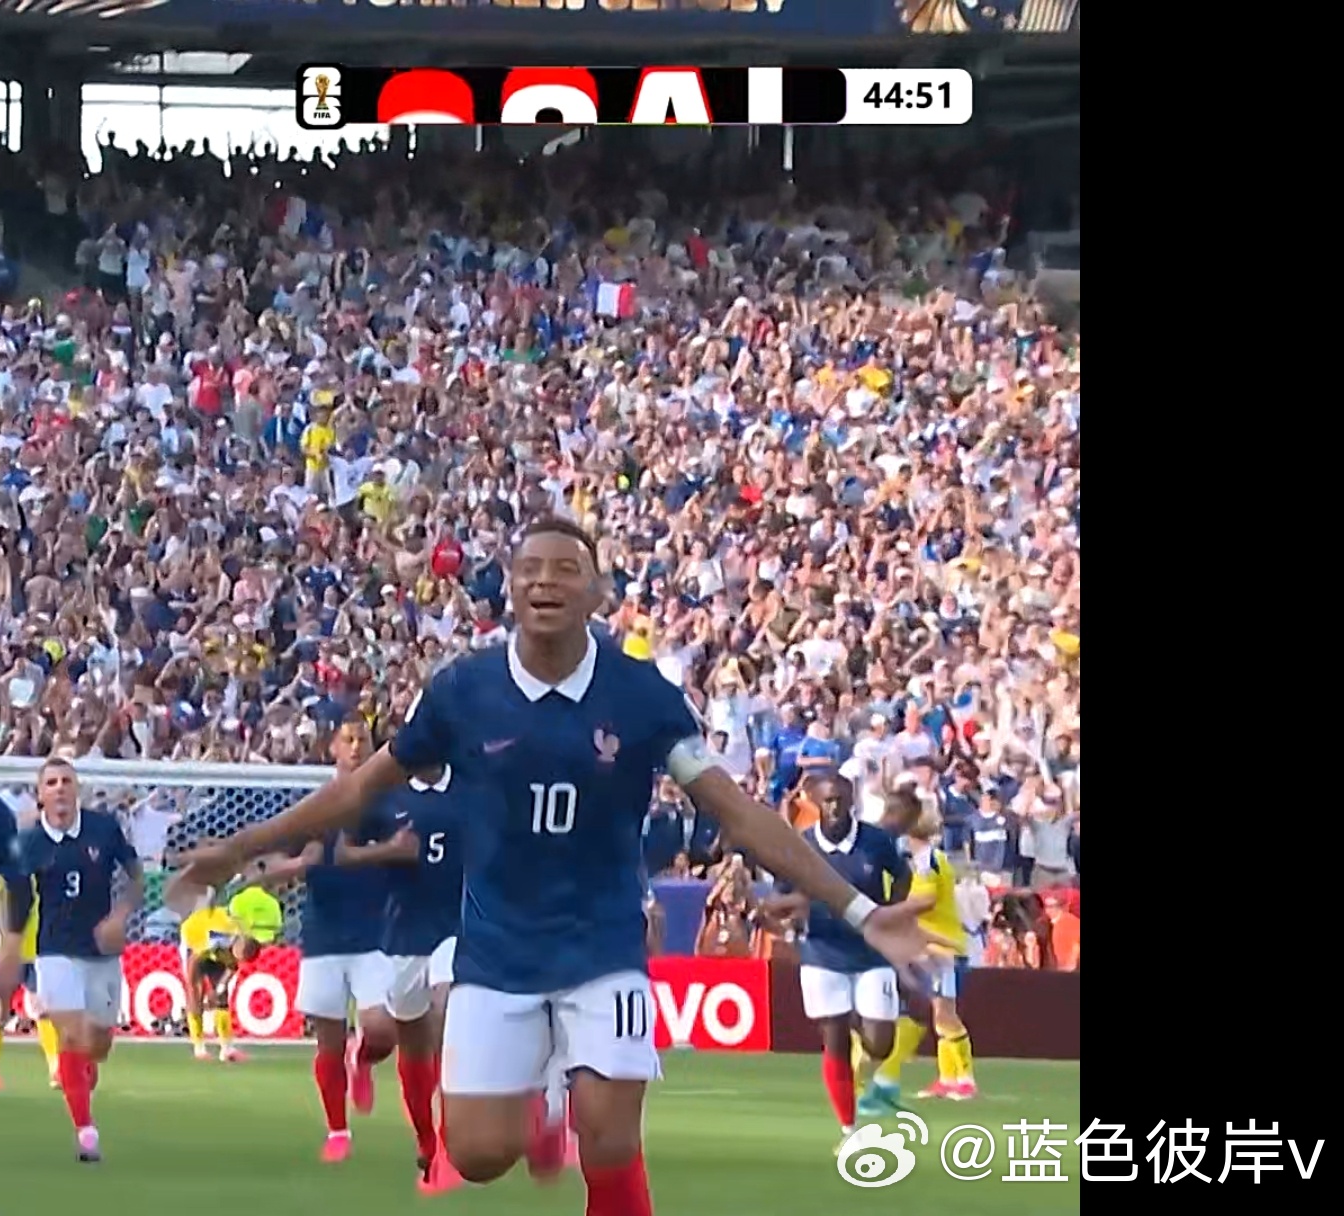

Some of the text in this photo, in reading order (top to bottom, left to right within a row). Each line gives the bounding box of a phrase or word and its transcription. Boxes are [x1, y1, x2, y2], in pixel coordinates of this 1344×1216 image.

[530, 783, 578, 833] 10
[427, 832, 445, 863] 5
[613, 990, 647, 1037] 10
